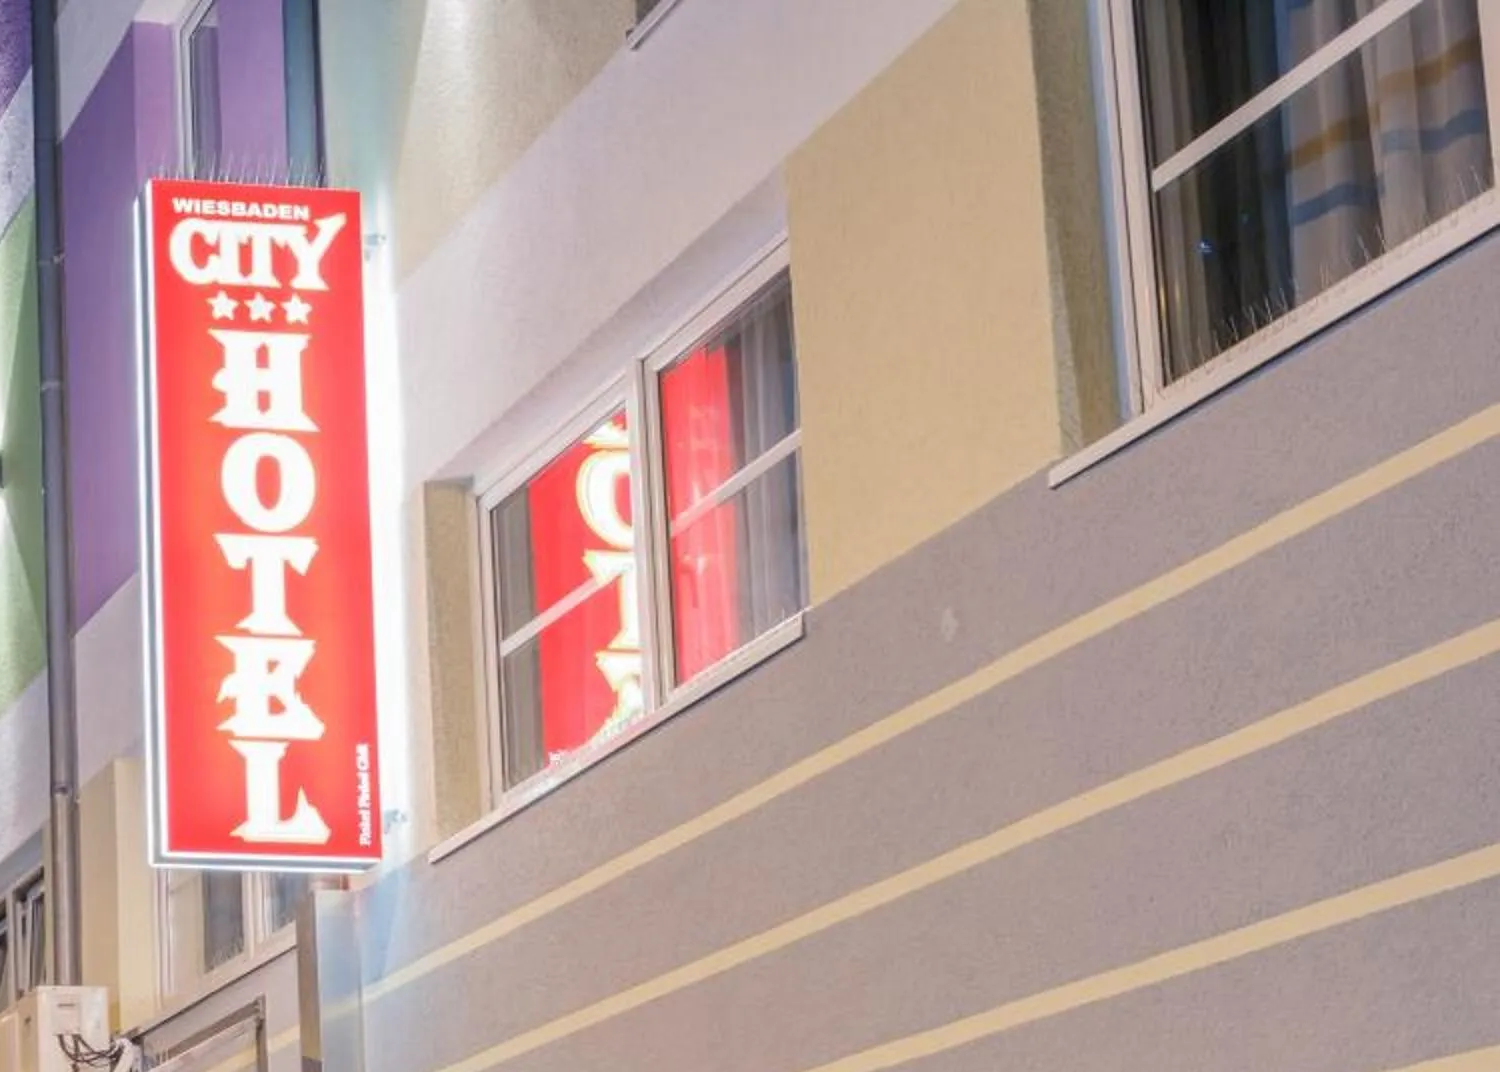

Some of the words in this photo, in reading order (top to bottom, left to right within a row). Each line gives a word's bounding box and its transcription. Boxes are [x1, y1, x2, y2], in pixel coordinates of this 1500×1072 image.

[172, 198, 309, 220] WIESBADEN
[169, 212, 347, 291] CITY
[207, 328, 331, 845] HOTEL
